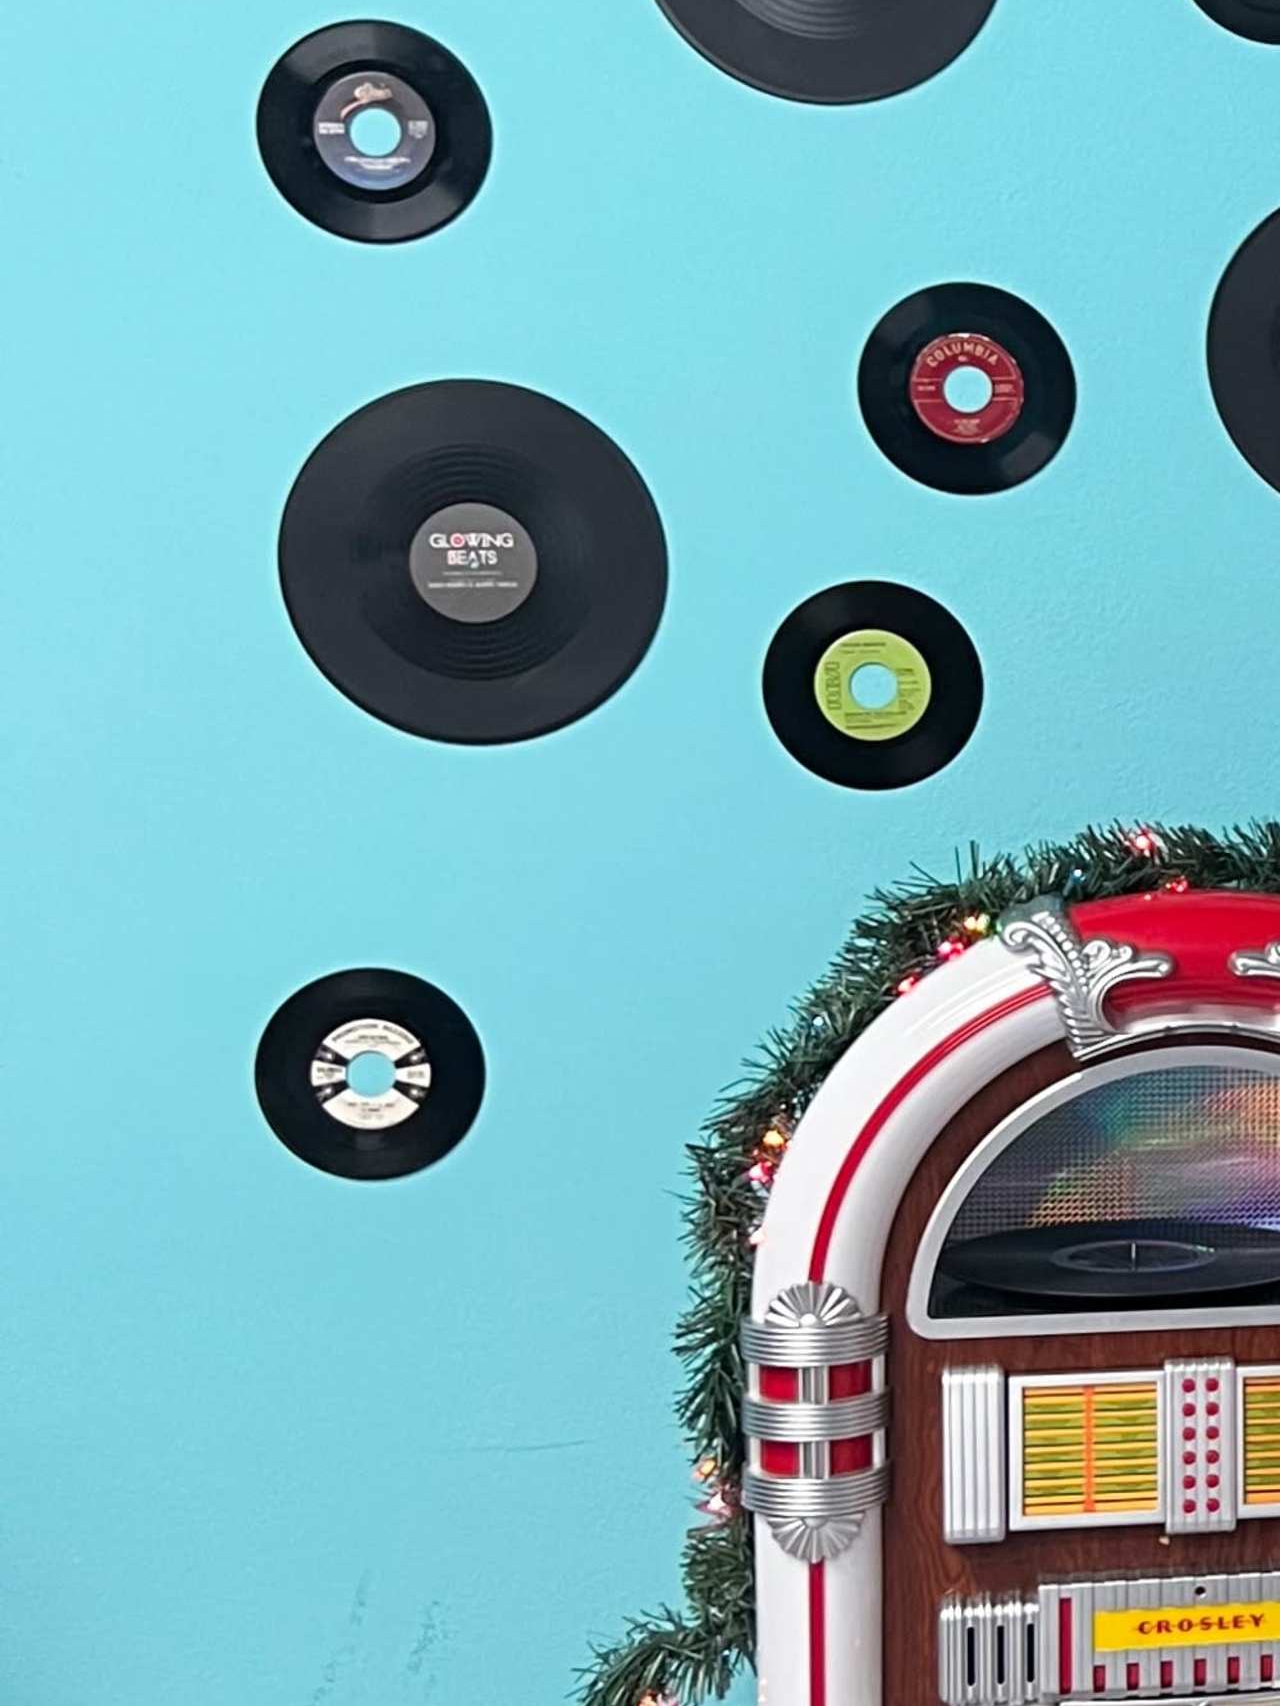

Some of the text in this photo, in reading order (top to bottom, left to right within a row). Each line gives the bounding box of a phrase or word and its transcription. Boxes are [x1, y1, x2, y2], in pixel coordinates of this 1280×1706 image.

[926, 341, 999, 368] COLUMBIA
[428, 532, 514, 548] GLOWING
[447, 549, 499, 568] BEATS
[1137, 1612, 1265, 1635] CROSLEY
